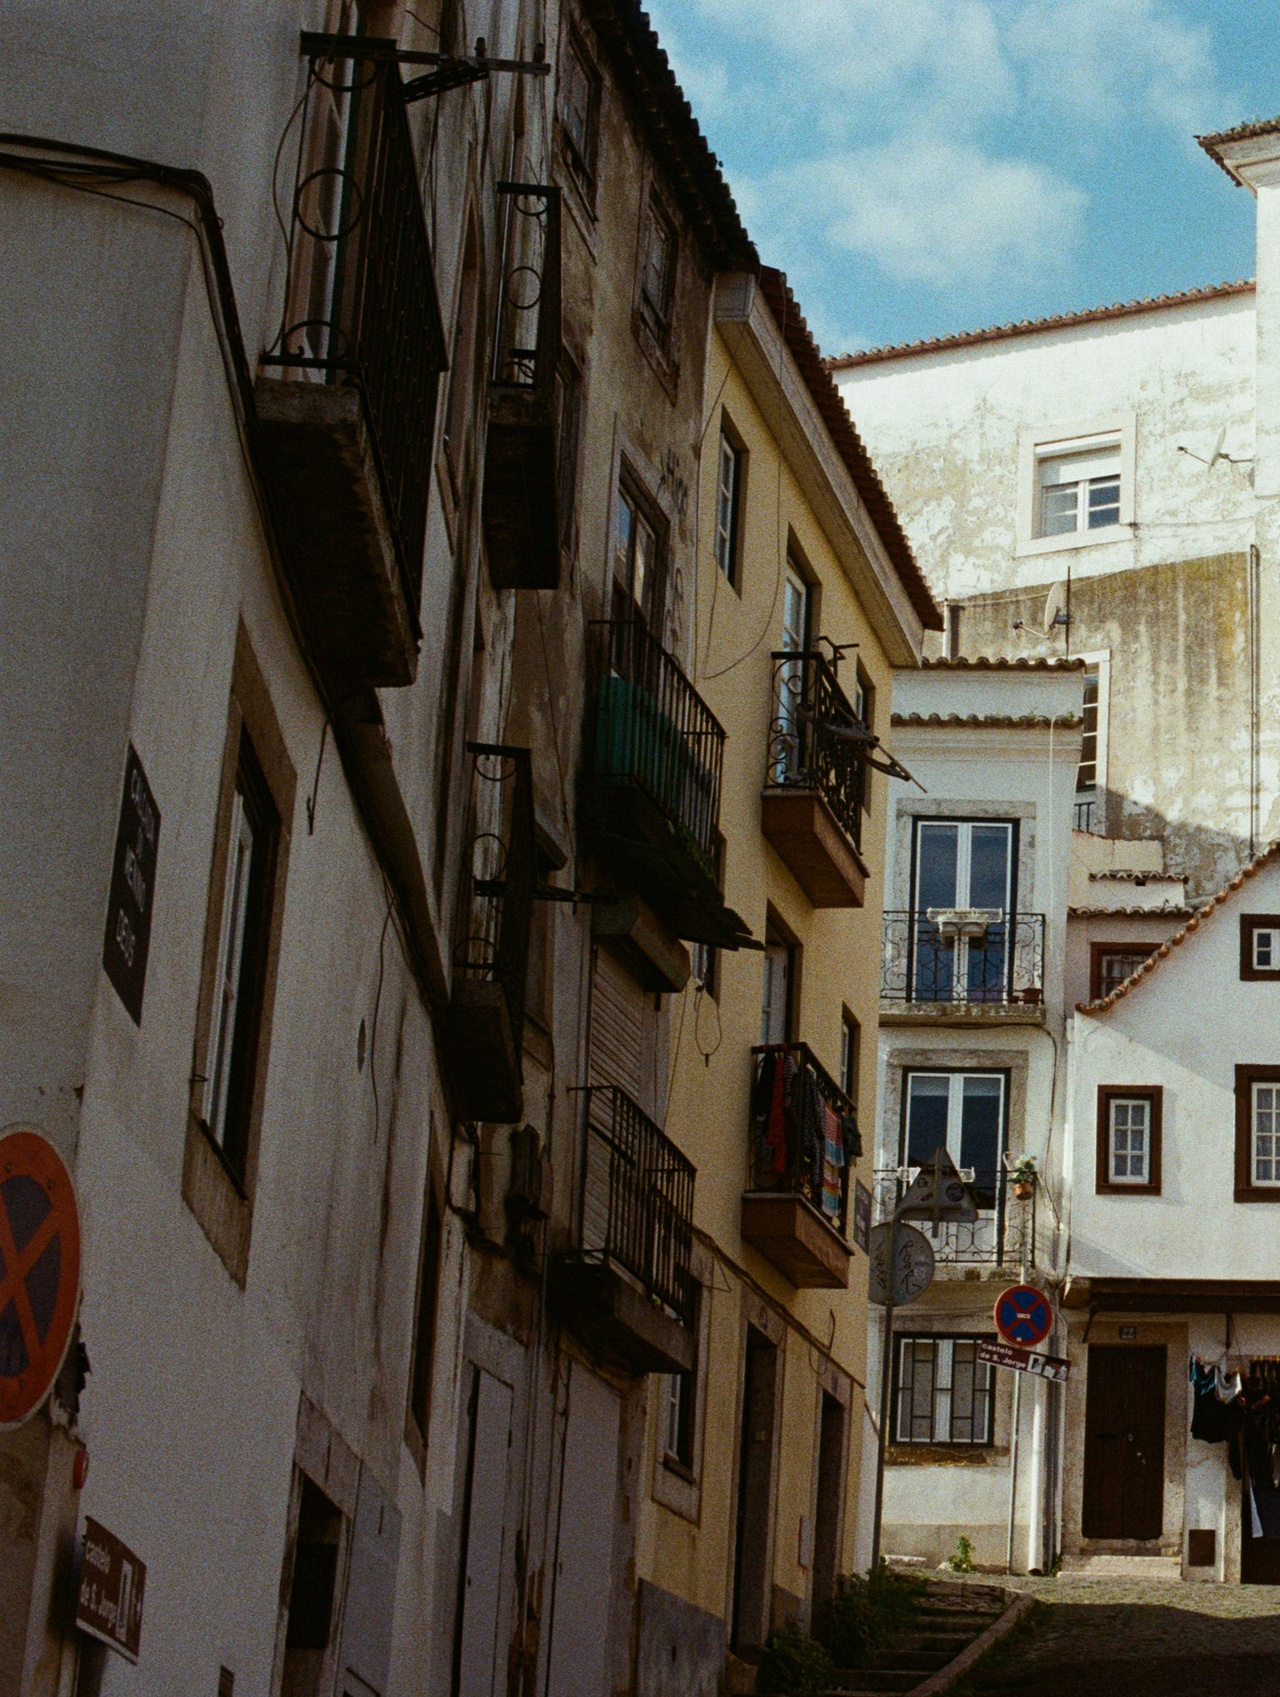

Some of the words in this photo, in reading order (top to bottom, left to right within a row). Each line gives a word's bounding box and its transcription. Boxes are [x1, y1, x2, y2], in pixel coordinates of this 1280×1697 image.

[982, 1343, 1013, 1356] castelo
[980, 1351, 990, 1359] de
[993, 1354, 1000, 1363] S.
[1002, 1357, 1027, 1369] Jorge
